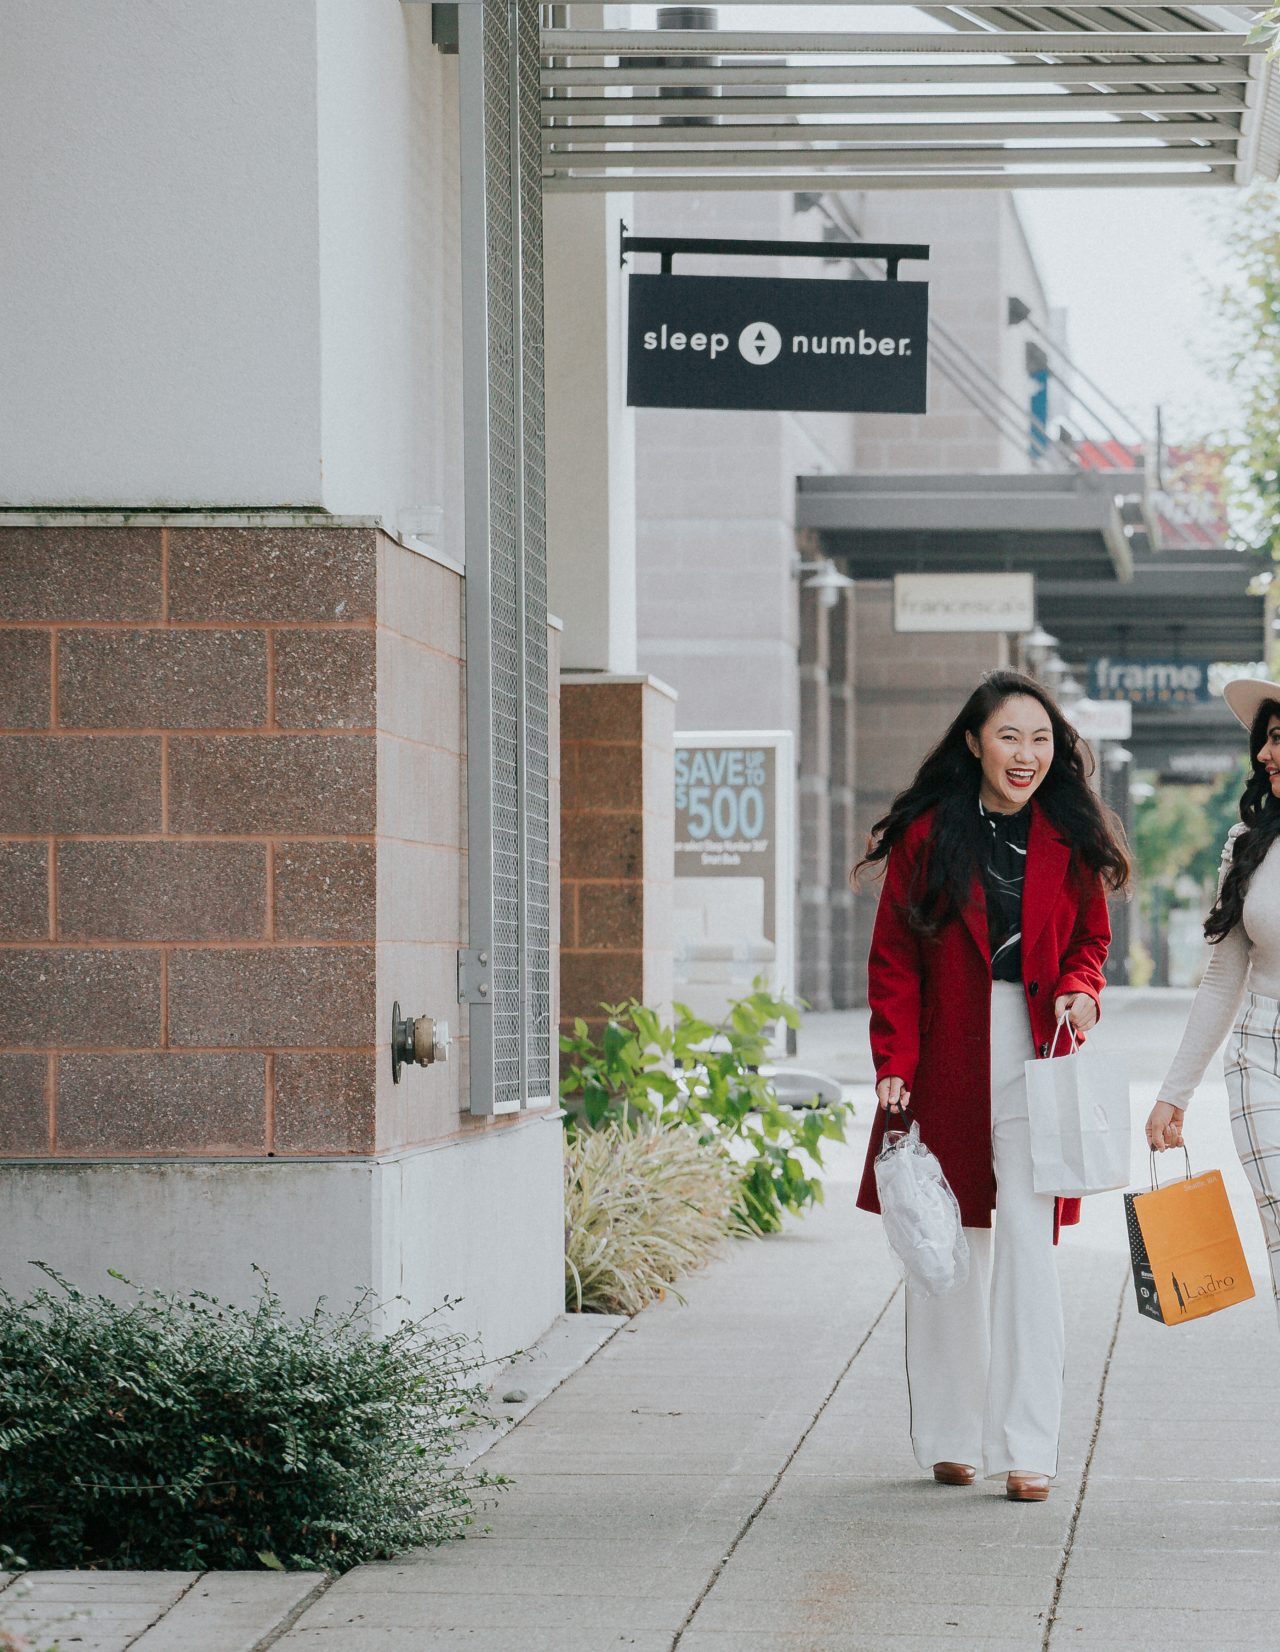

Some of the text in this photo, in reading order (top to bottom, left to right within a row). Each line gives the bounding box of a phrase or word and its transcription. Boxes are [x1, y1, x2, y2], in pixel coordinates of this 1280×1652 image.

[643, 323, 729, 360] sleep
[1096, 658, 1201, 690] frame
[675, 750, 745, 786] SAVE
[745, 767, 766, 786] TO
[1183, 1274, 1235, 1299] Ladro
